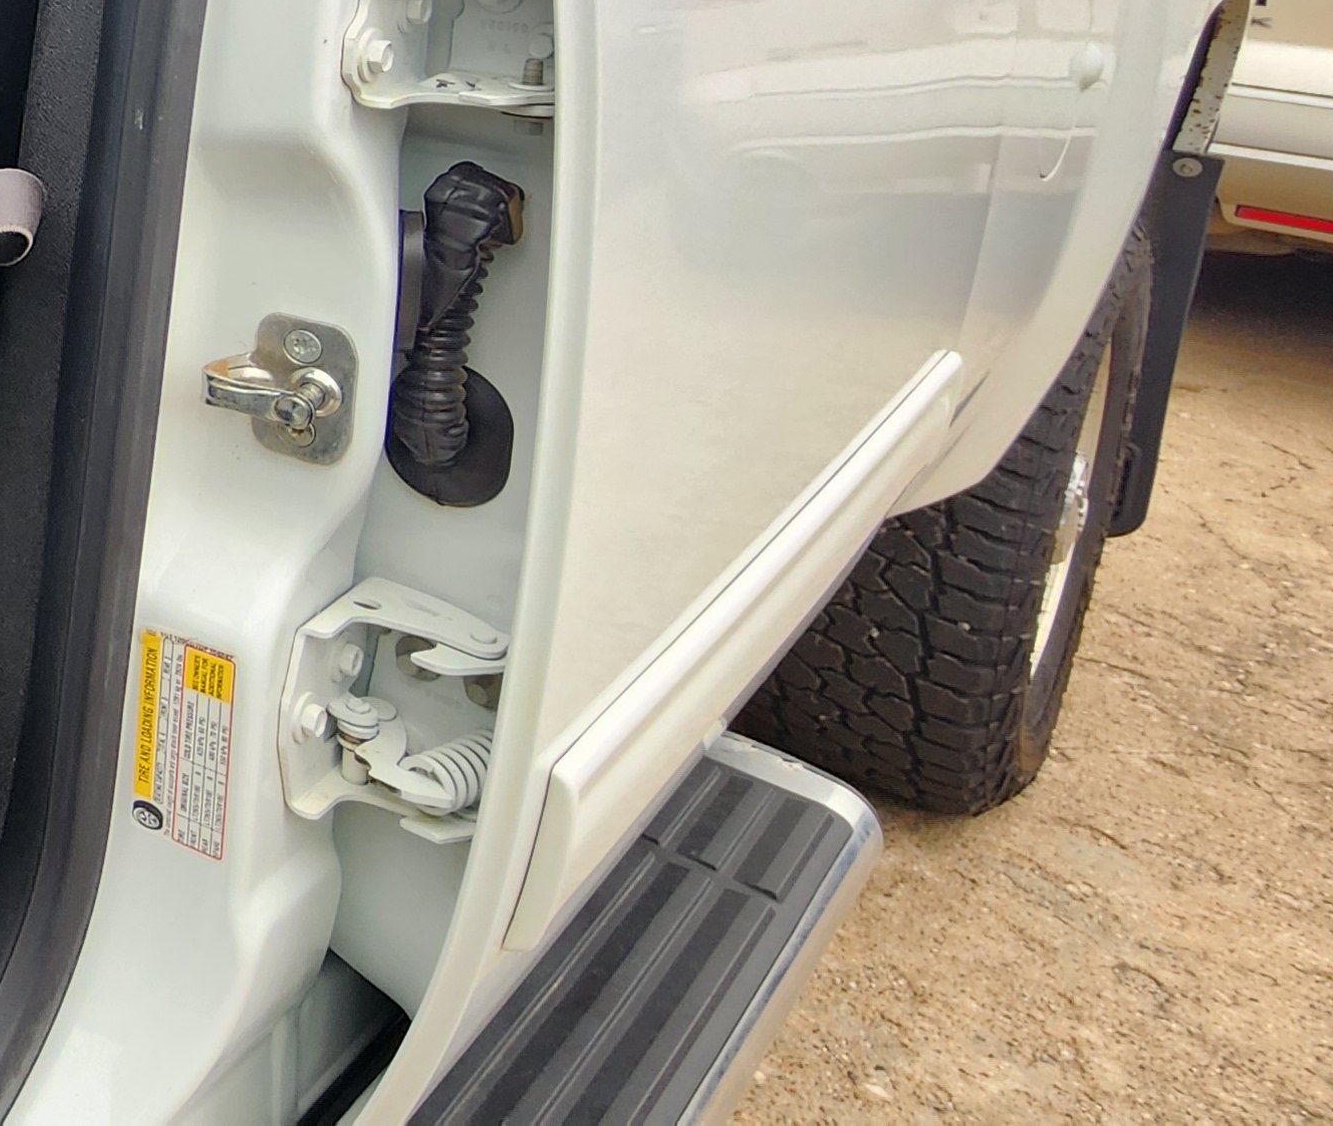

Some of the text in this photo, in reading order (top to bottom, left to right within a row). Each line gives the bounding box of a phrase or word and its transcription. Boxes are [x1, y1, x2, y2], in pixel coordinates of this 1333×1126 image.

[138, 647, 157, 783] TIRE AND LOADING INFORMATION
[185, 701, 194, 730] PRESSURE
